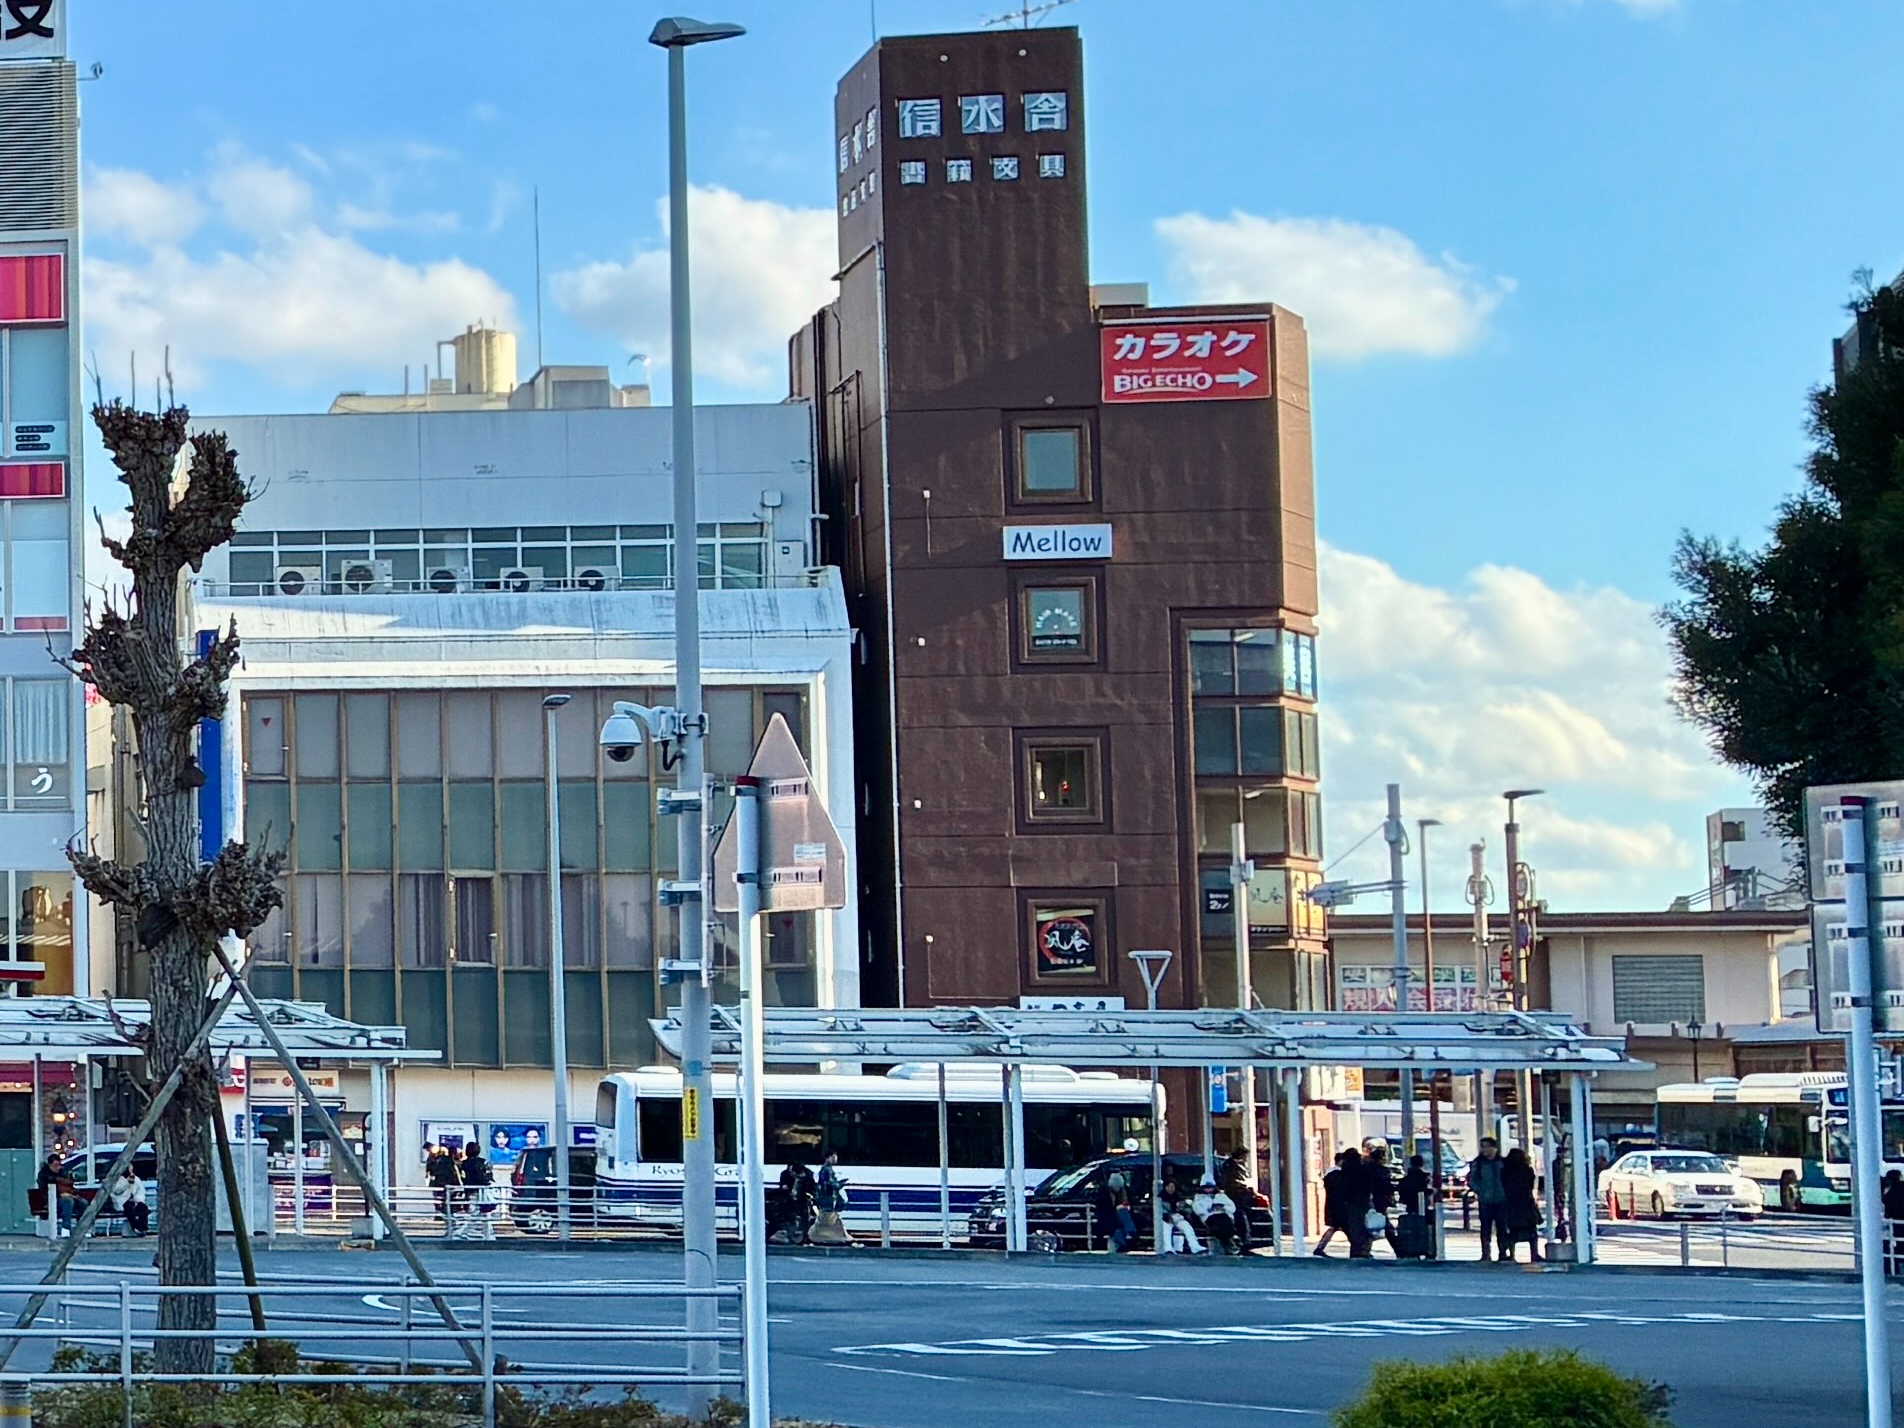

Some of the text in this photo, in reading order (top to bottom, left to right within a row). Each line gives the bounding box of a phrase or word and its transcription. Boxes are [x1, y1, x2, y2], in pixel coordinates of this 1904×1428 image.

[901, 94, 1065, 138] 信水舎
[1113, 330, 1256, 361] カラオケ
[1114, 372, 1214, 394] BIG ECHO
[1011, 530, 1102, 556] Mellow
